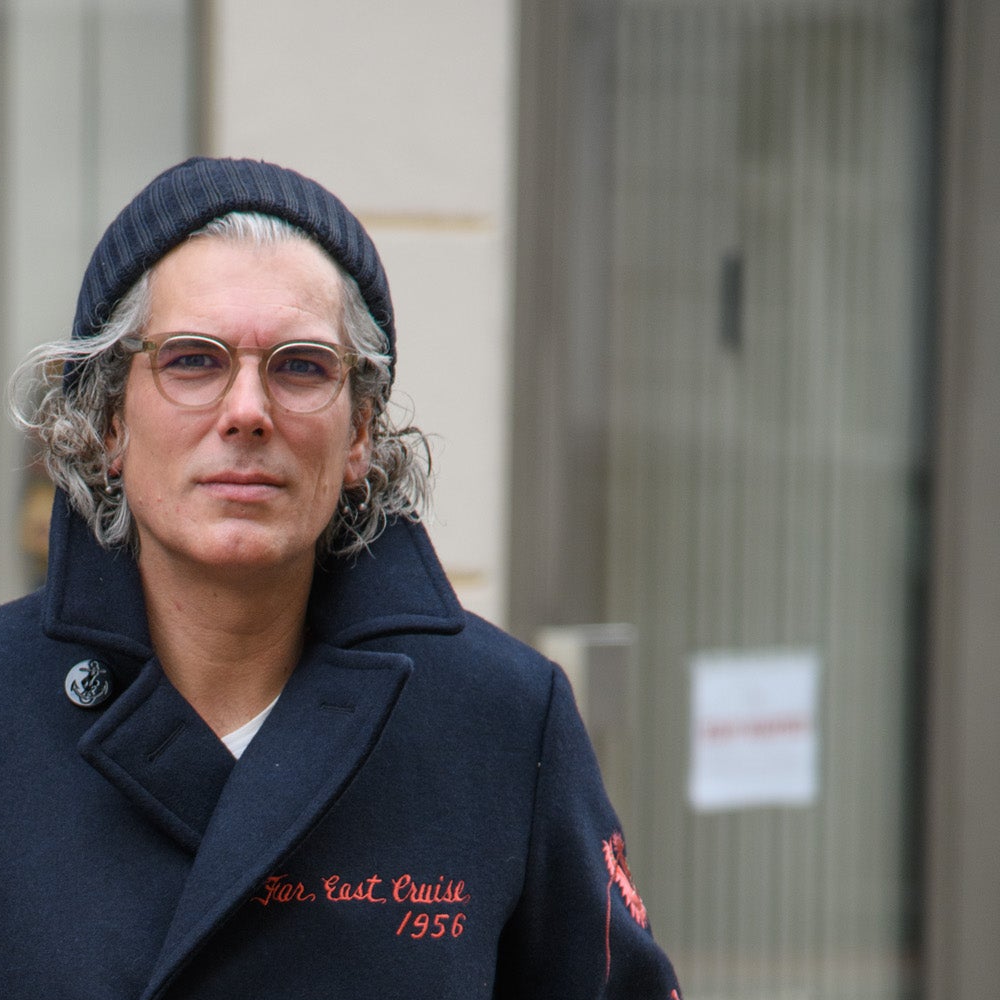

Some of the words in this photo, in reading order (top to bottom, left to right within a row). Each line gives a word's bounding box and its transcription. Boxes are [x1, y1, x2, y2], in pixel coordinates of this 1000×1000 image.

[250, 874, 316, 906] Far
[321, 874, 387, 904] East
[391, 873, 470, 905] Cruise
[397, 911, 467, 939] 1956
